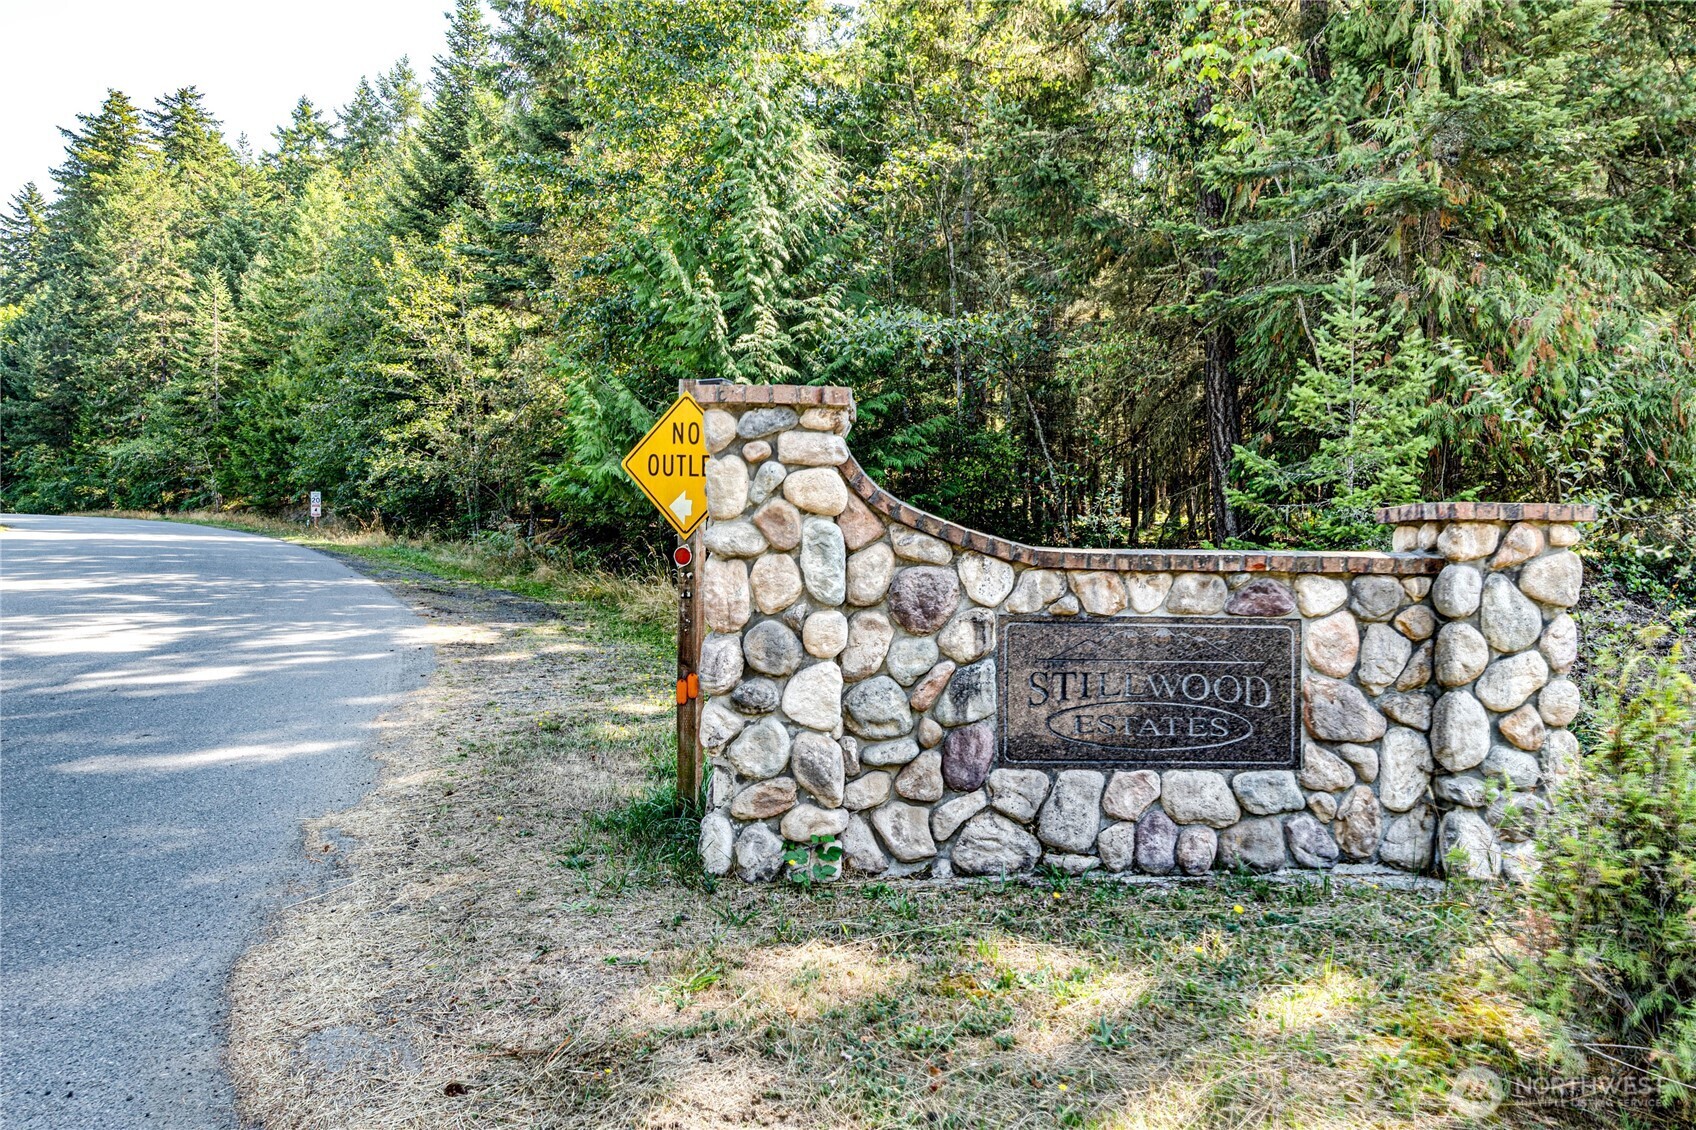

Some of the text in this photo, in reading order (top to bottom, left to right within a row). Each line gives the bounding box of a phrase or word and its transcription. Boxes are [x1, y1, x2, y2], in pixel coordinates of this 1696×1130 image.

[672, 422, 700, 445] NO
[1029, 671, 1270, 708] STILLWOOD
[1074, 714, 1230, 737] ESTATES
